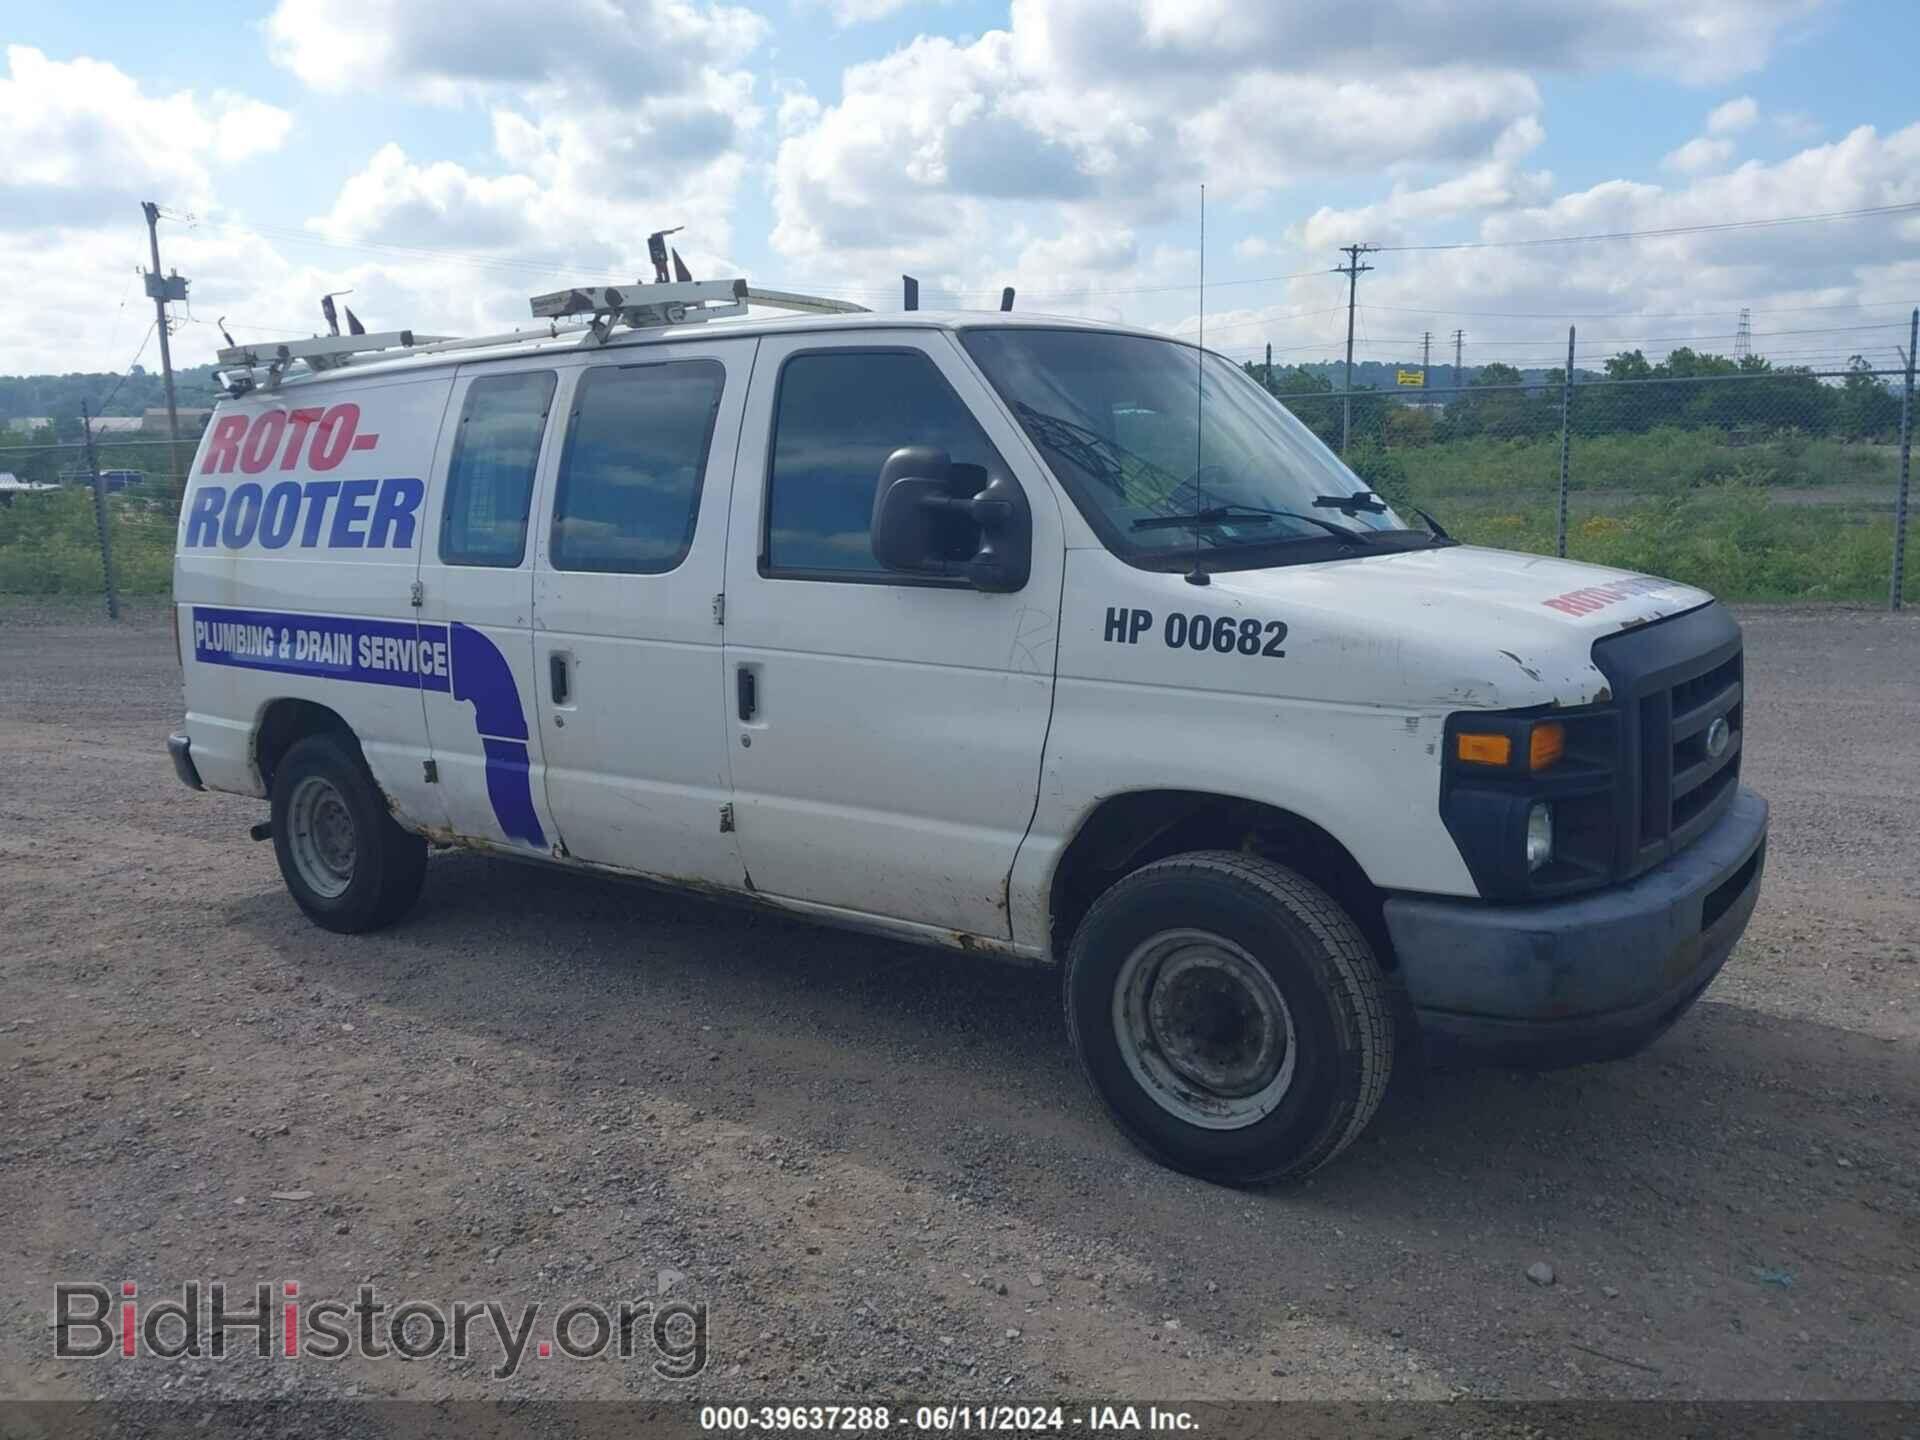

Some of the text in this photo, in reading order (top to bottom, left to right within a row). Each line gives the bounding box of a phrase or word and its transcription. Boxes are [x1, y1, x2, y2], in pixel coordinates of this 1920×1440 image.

[200, 403, 379, 475] ROTO-
[184, 478, 425, 549] ROOTER
[195, 621, 448, 676] PLUMBING & DRAIN SERVICE
[1103, 607, 1288, 658] HP 00682
